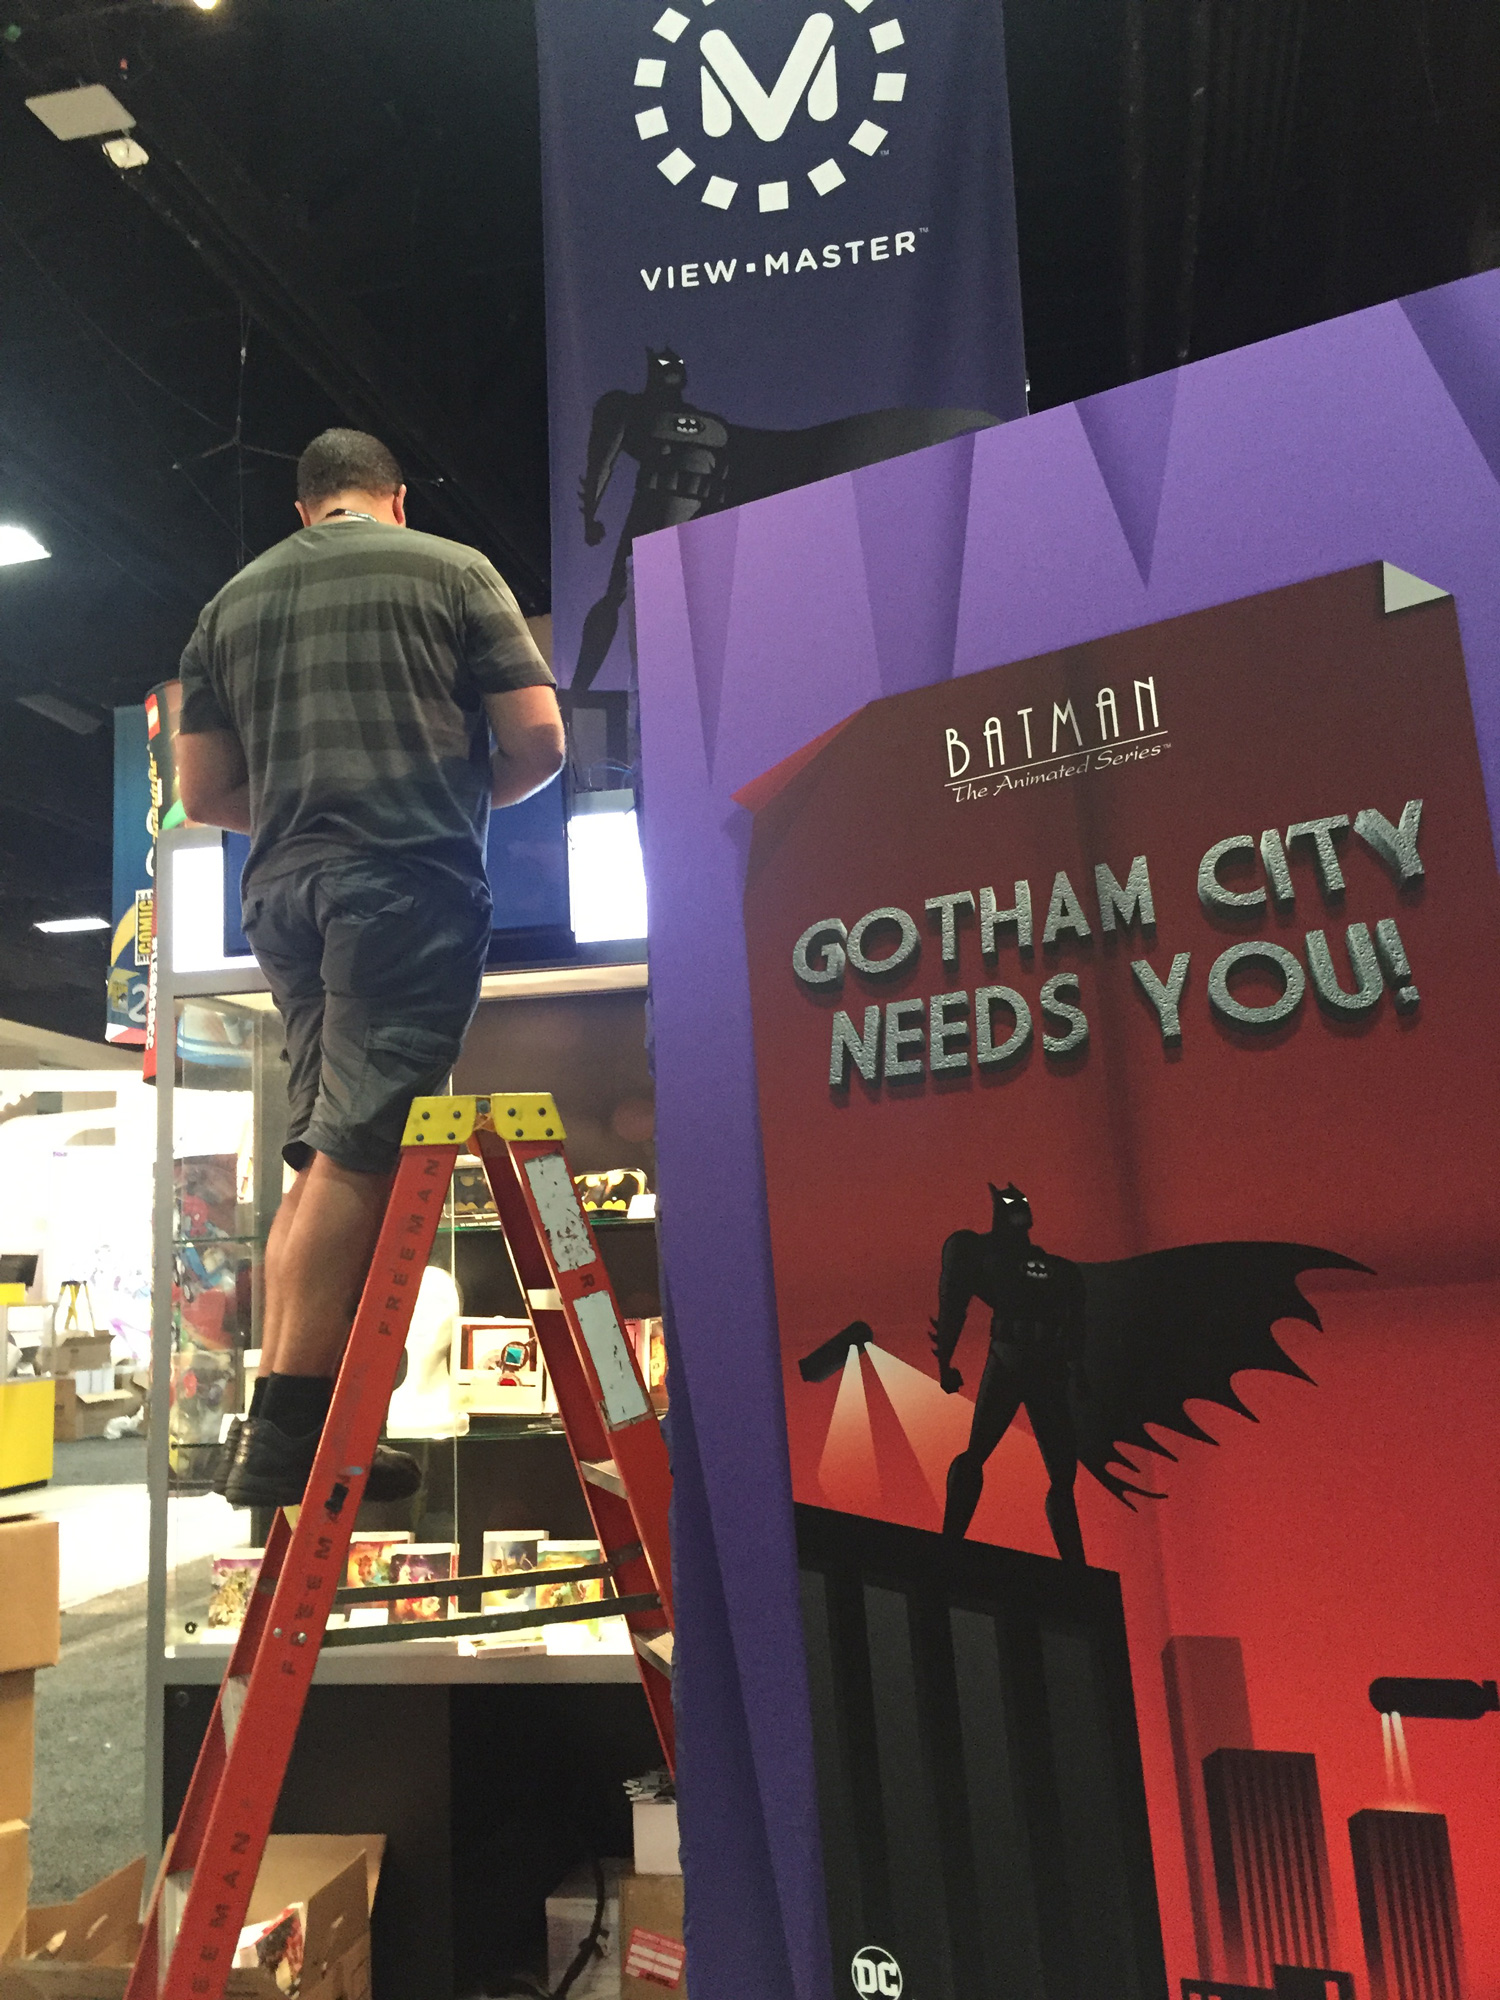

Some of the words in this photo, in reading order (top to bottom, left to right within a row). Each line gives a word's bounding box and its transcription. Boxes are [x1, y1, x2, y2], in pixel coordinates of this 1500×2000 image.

[945, 676, 1160, 778] BATMAN
[952, 783, 988, 803] The
[993, 755, 1090, 797] Animated
[1095, 744, 1161, 770] Series
[138, 900, 153, 954] COMIC
[791, 855, 1157, 987] GOTHAM
[1196, 799, 1426, 913] CITY
[828, 972, 1089, 1090] NEEDS
[1131, 919, 1421, 1046] YOU!
[378, 1158, 440, 1337] FREEMAN
[852, 1958, 900, 1998] DC
